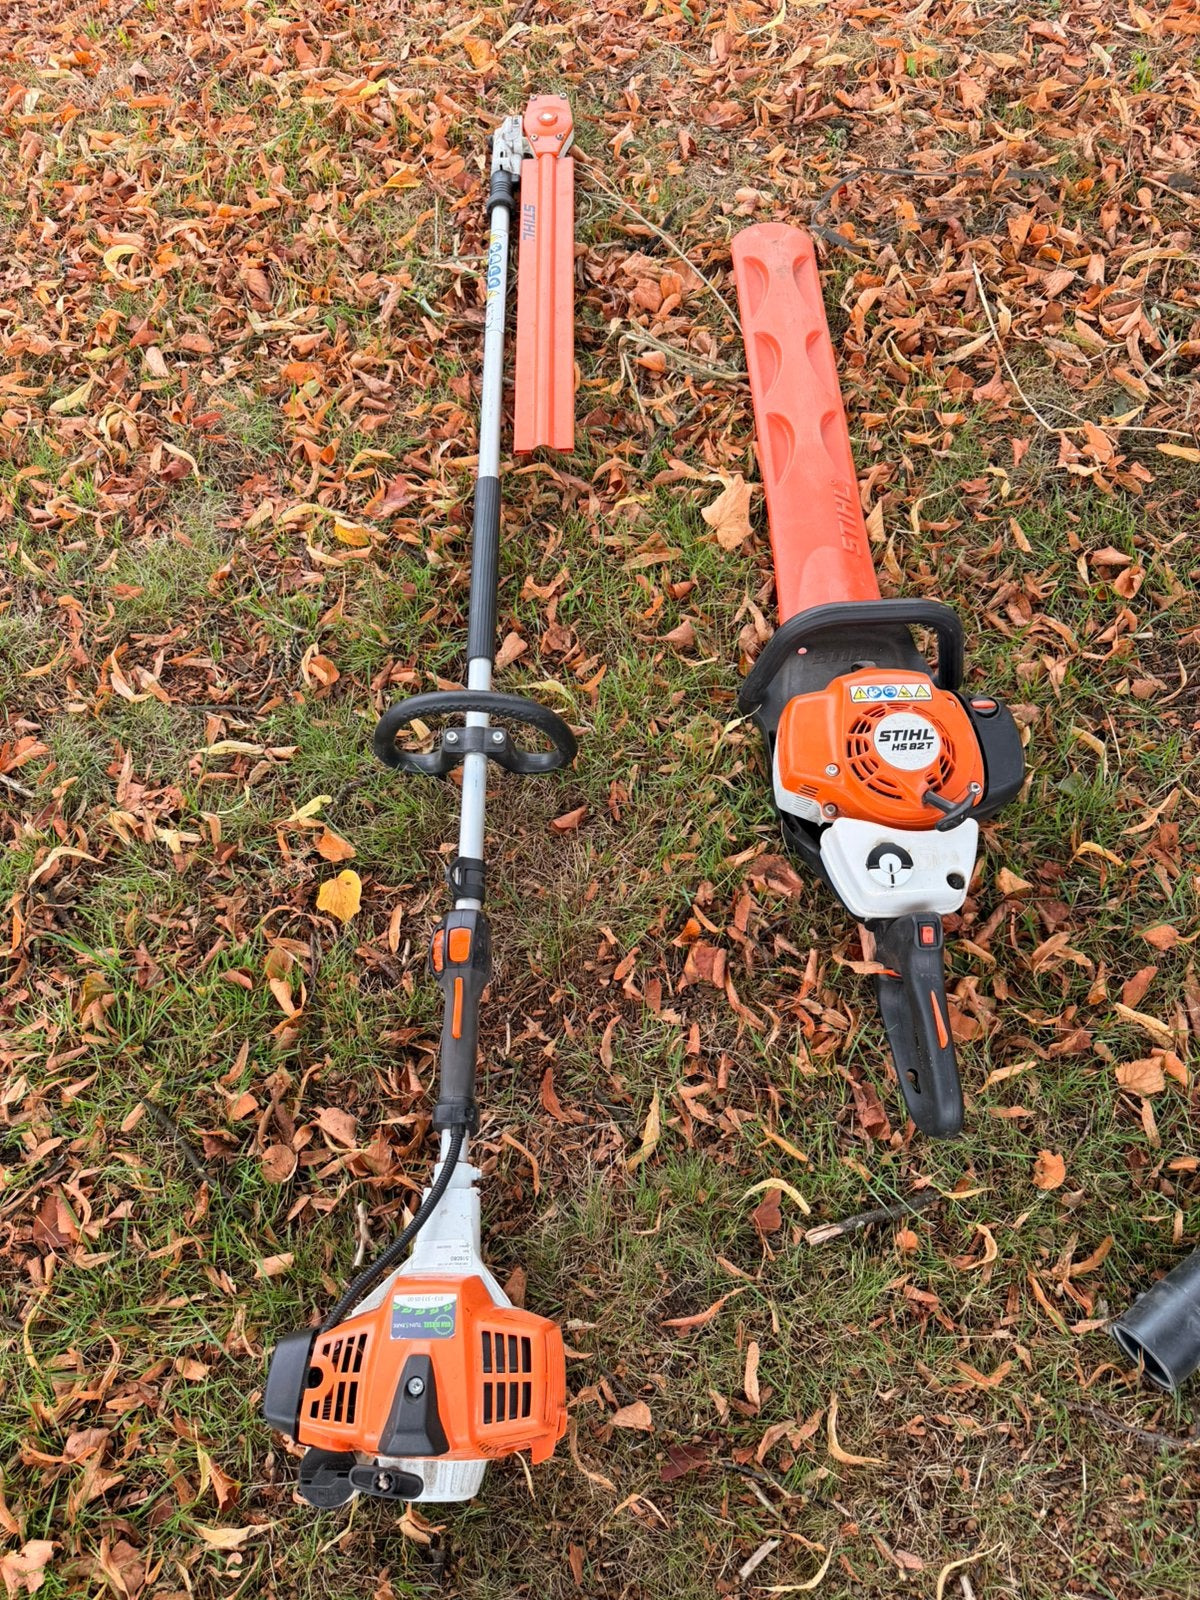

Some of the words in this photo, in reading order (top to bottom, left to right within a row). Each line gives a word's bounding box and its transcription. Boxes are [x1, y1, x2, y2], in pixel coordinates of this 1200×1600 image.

[523, 203, 536, 241] STIHL
[833, 485, 862, 559] STIHL
[878, 728, 935, 743] STIHL
[891, 743, 908, 751] HS
